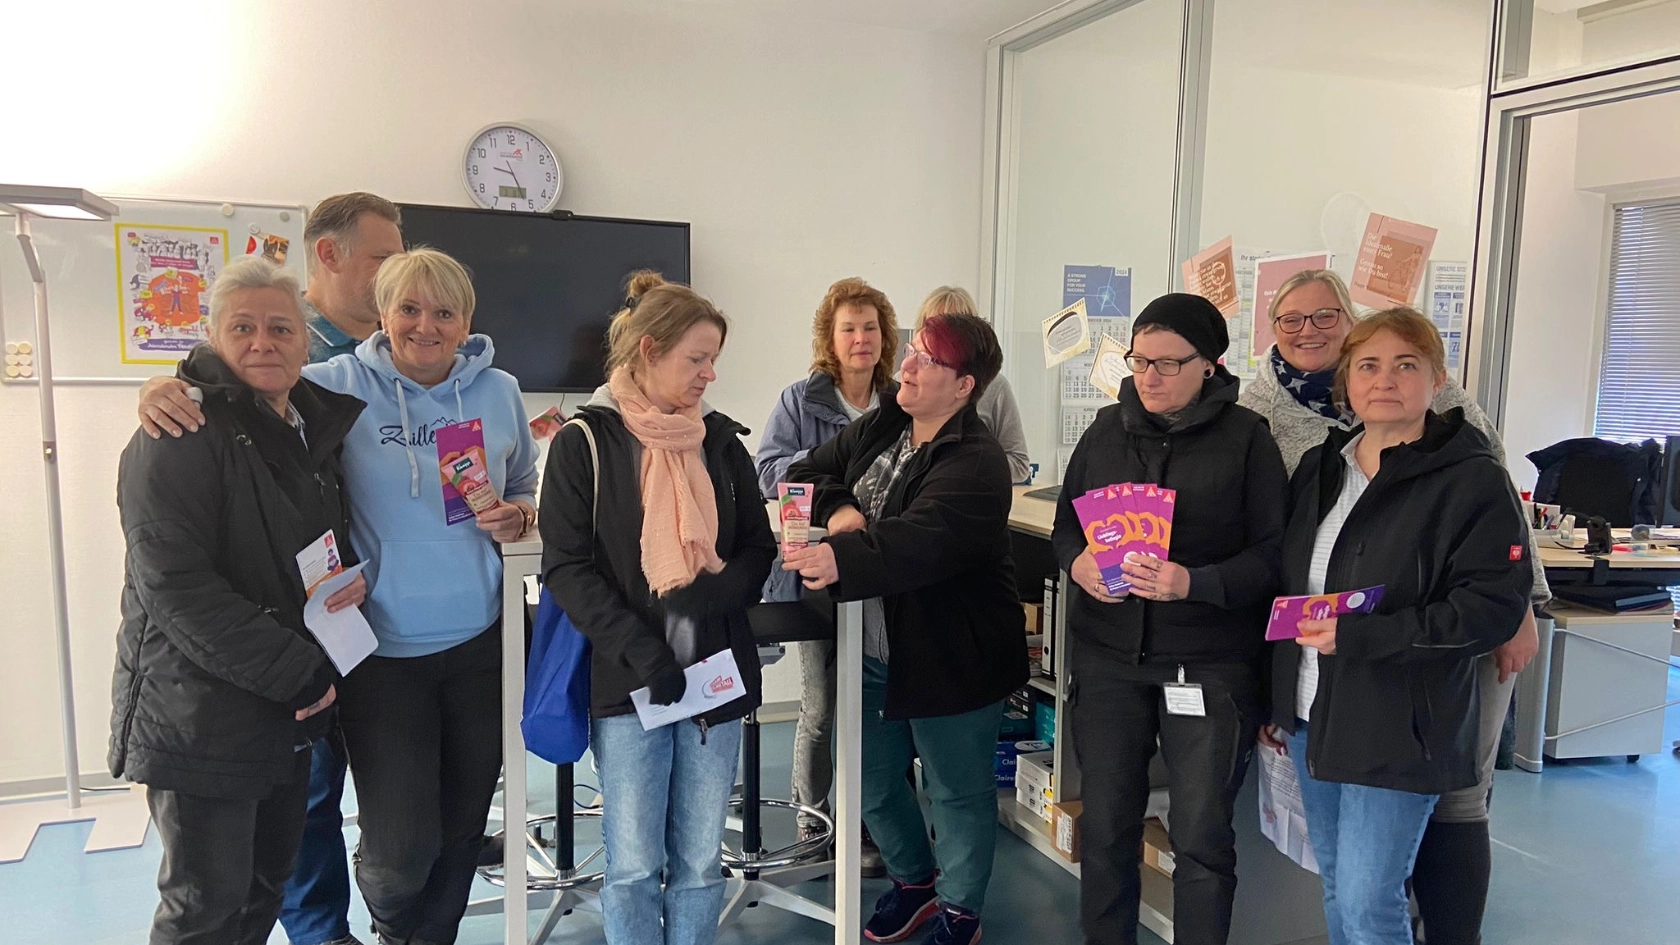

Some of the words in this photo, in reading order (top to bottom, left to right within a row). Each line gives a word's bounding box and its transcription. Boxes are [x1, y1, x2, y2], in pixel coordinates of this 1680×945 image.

[489, 138, 497, 148] 11
[507, 135, 515, 145] 12
[526, 142, 530, 151] 1
[477, 148, 486, 158] 10
[539, 155, 545, 164] 2
[472, 165, 478, 175] 9
[545, 172, 551, 182] 3
[480, 183, 485, 193] 8
[540, 189, 546, 198] 4
[493, 196, 498, 206] 7
[528, 199, 534, 209] 5
[511, 203, 516, 211] 6
[1002, 758, 1016, 766] Clai
